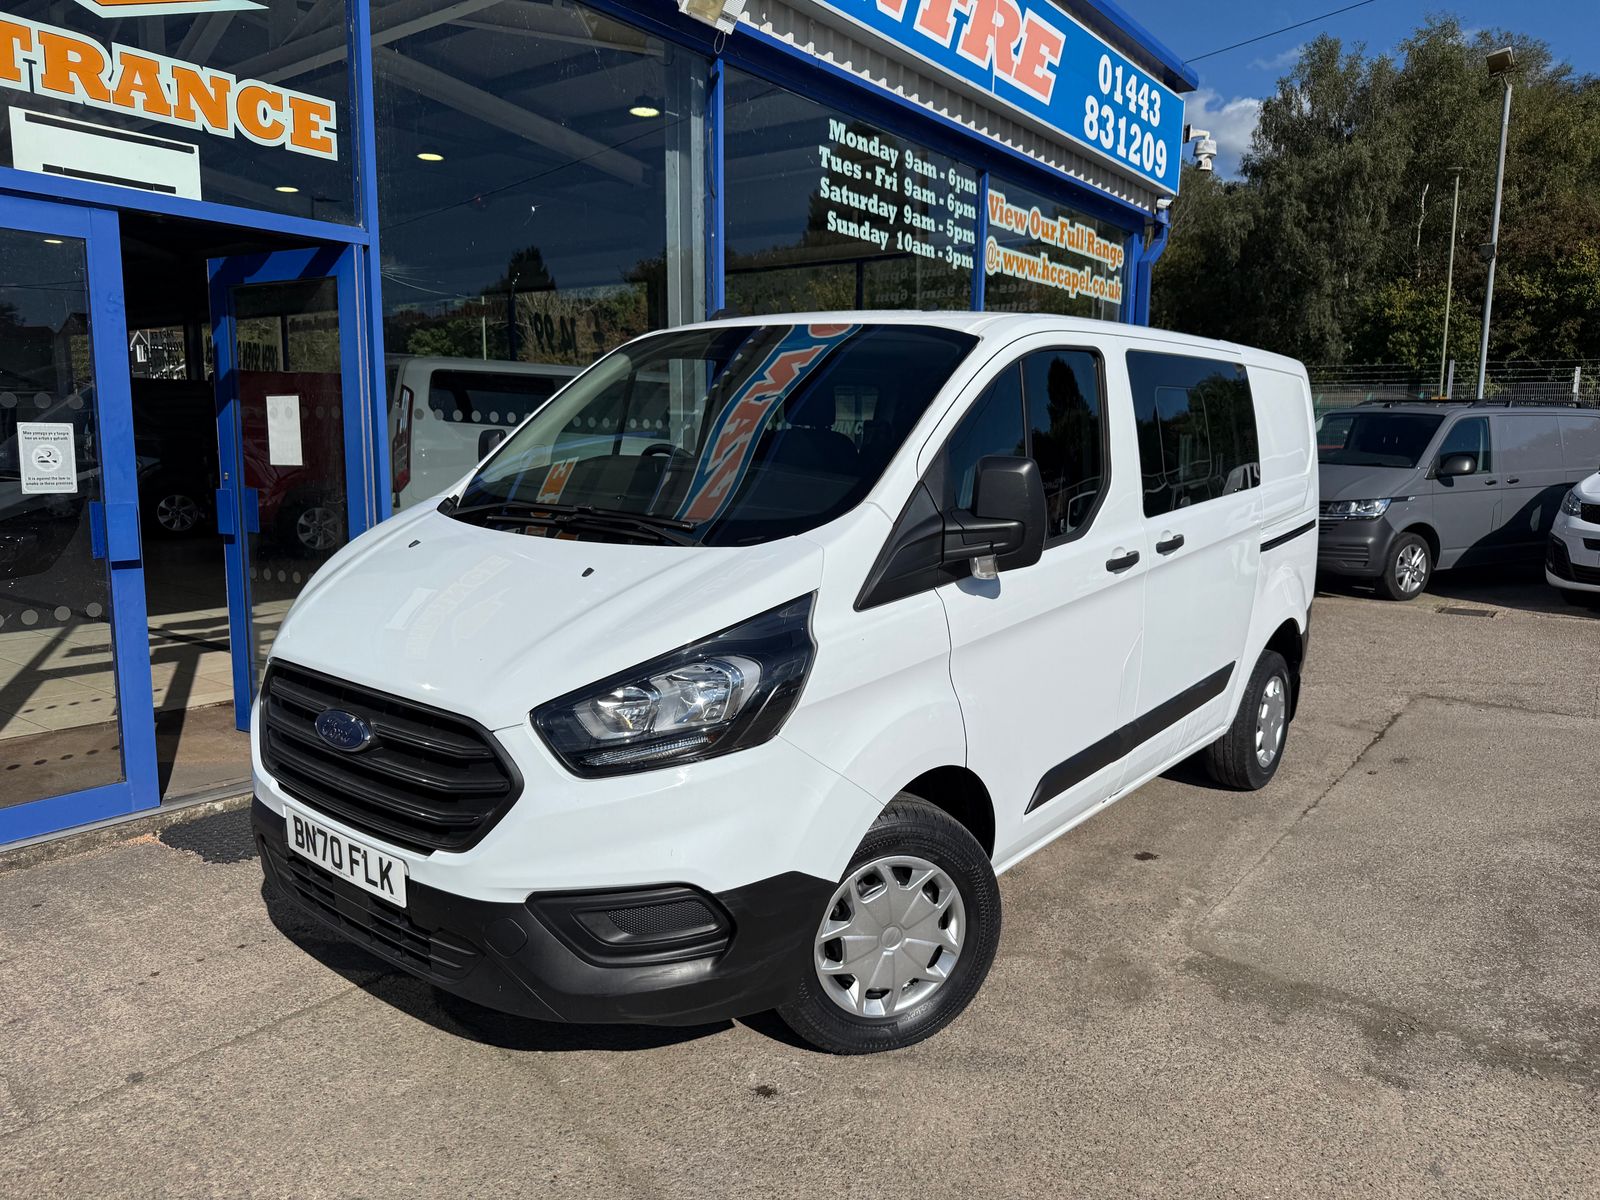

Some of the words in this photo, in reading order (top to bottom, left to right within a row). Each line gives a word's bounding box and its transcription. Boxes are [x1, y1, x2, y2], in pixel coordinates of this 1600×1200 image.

[1098, 54, 1161, 127] 01443
[829, 118, 899, 169] Monday
[905, 150, 937, 179] 9am
[948, 168, 977, 195] 6pm
[1083, 95, 1167, 178] 831209
[818, 145, 862, 180] Tues
[875, 165, 898, 192] Fri
[904, 177, 936, 205] 9am
[947, 195, 976, 220] 6pm
[820, 176, 897, 225] Saturday
[904, 205, 935, 232] 9am
[946, 219, 975, 244] 5pm
[827, 210, 890, 251] Sunday
[896, 231, 935, 259] 10am
[945, 246, 974, 270] 3pm
[988, 191, 1028, 234] View
[1029, 208, 1057, 244] Our
[1058, 218, 1085, 253] Full
[1086, 230, 1124, 269] Range
[1003, 250, 1122, 302] www.hccapel.co.uk
[293, 815, 343, 870] BN70
[348, 843, 394, 895] FLK
